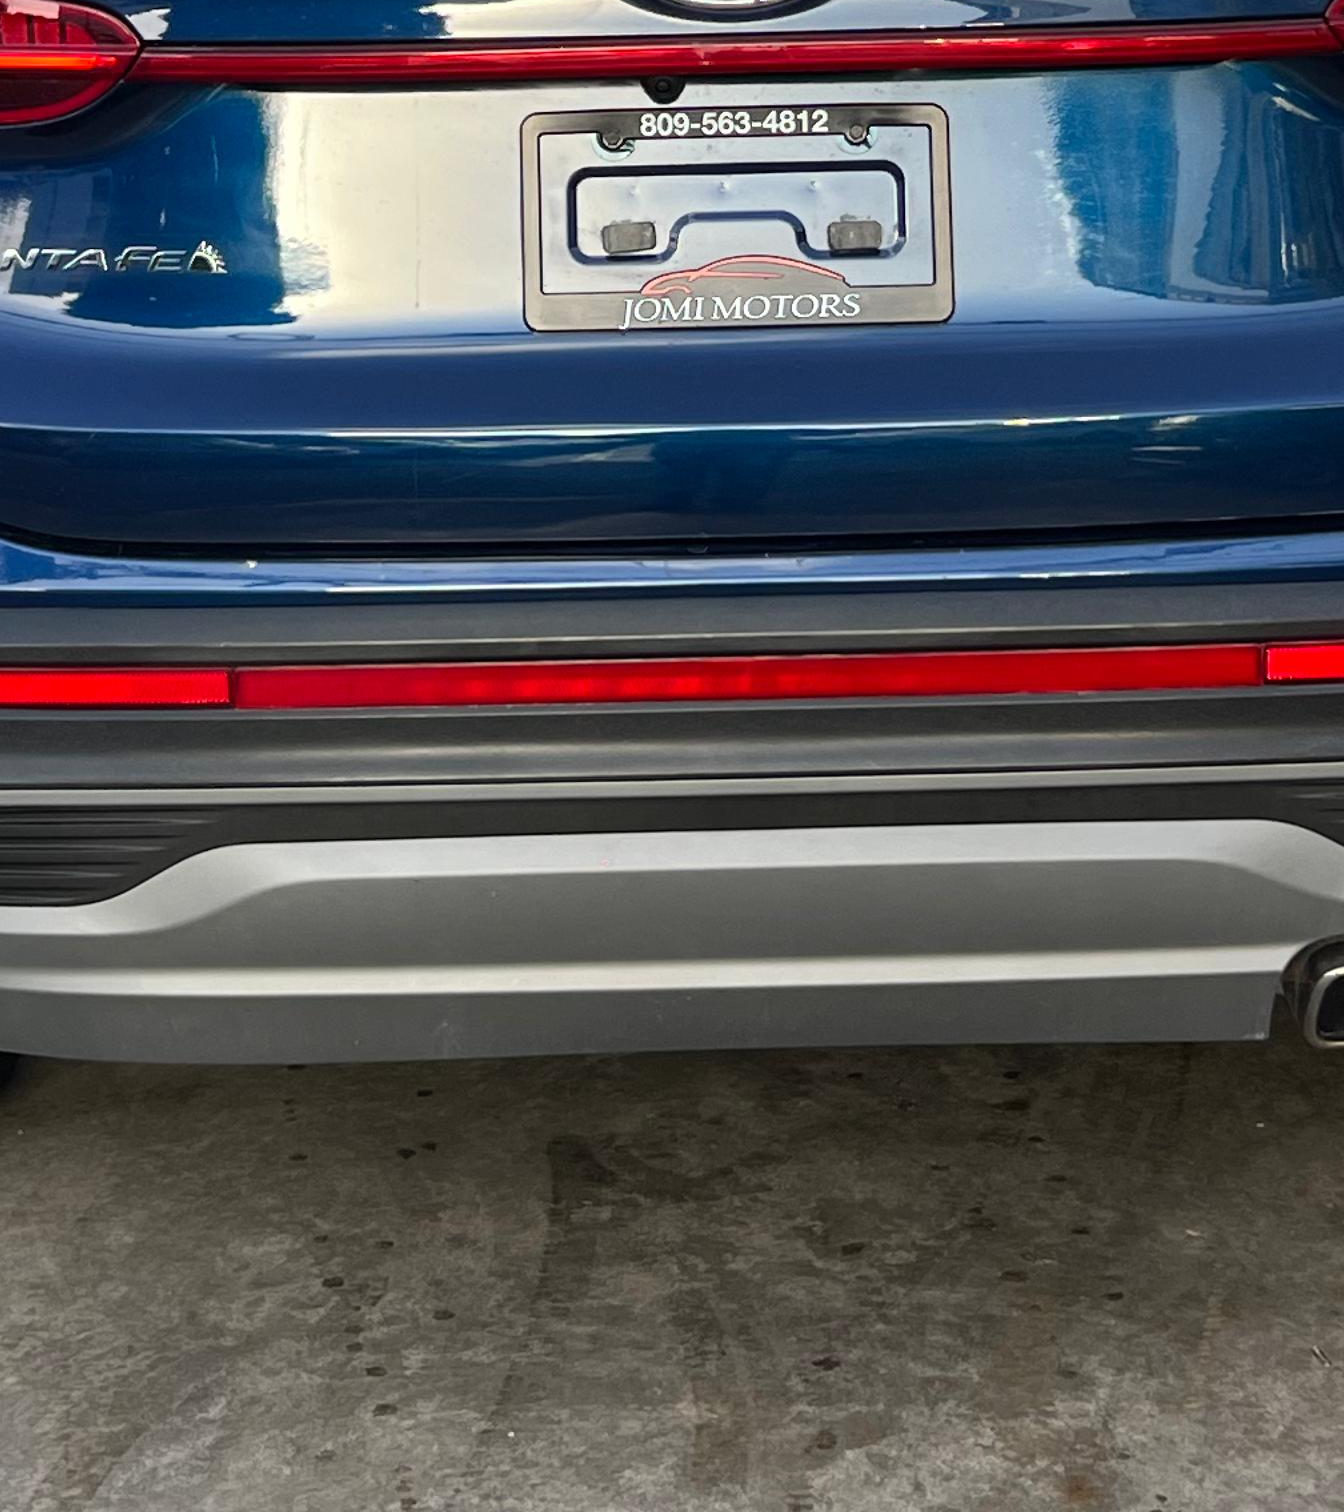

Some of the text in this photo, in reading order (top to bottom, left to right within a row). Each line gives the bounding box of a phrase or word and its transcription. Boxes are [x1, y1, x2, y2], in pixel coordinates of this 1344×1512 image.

[639, 108, 829, 137] 809-563-4812
[618, 293, 862, 331] JOMI MOTORS
